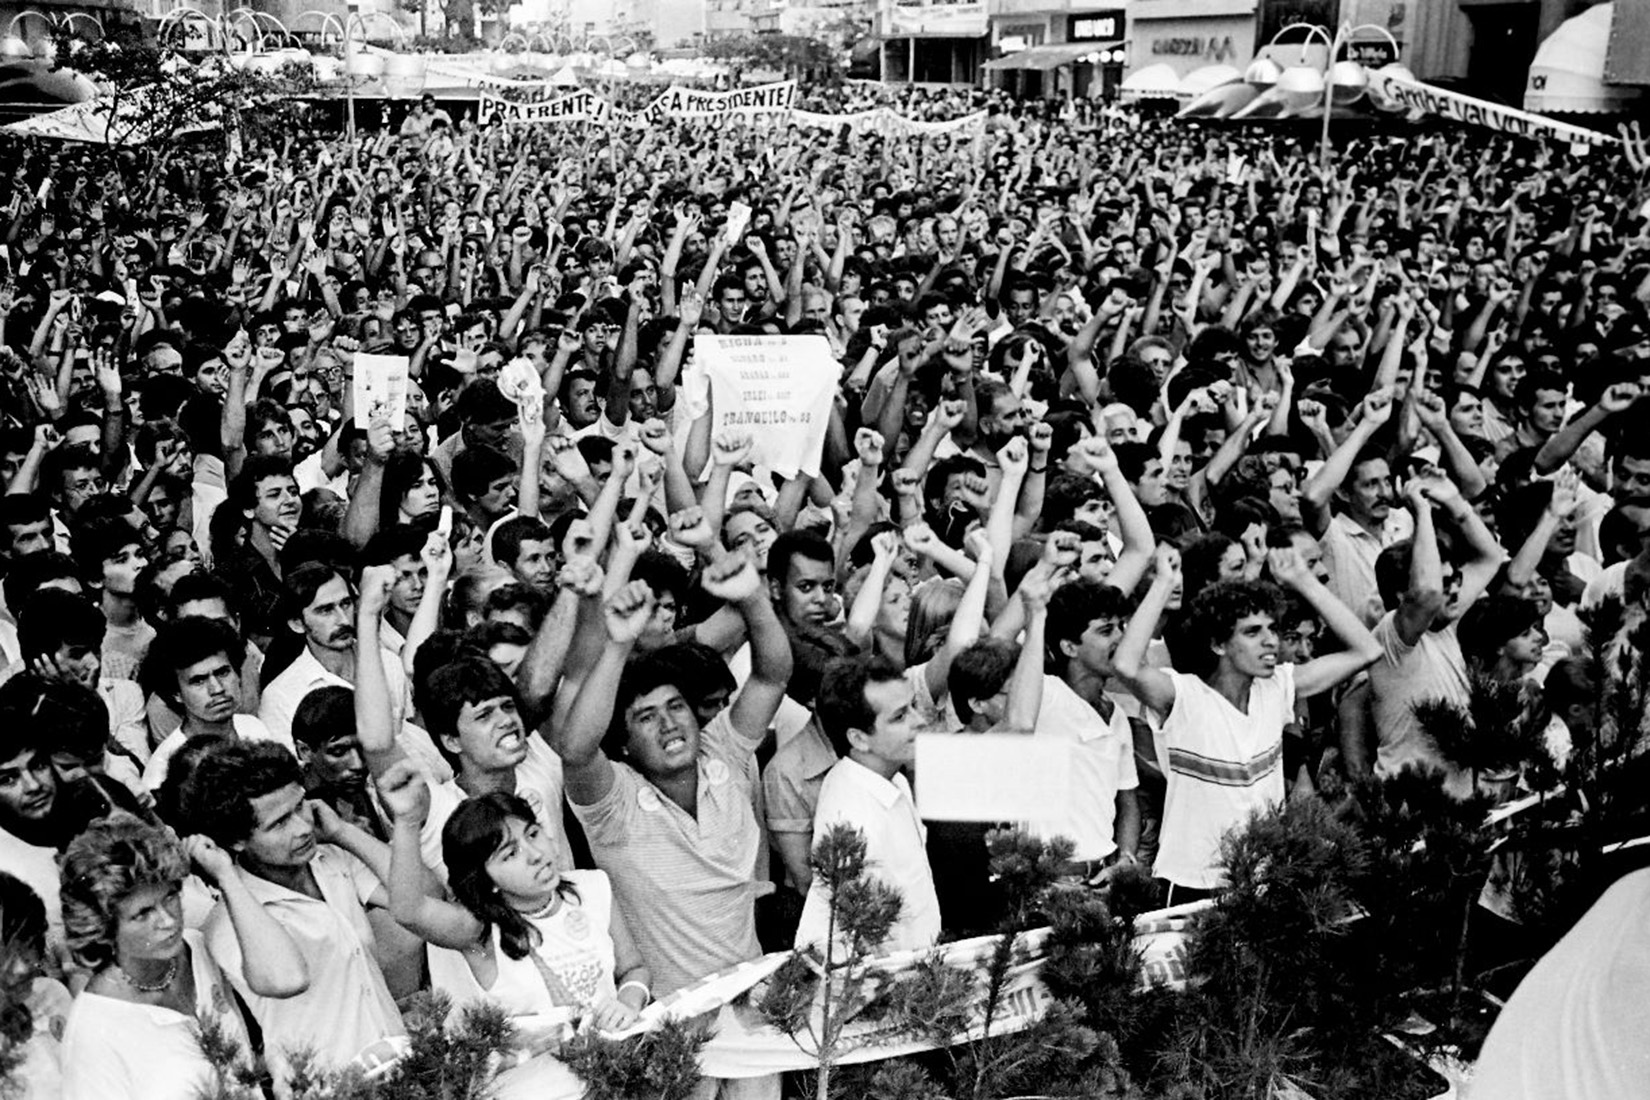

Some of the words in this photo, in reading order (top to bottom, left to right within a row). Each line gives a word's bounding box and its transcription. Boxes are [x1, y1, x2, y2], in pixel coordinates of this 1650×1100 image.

[482, 97, 521, 120] PRA
[526, 93, 604, 121] FRENTE!
[686, 84, 794, 112] PRESIDENTE!
